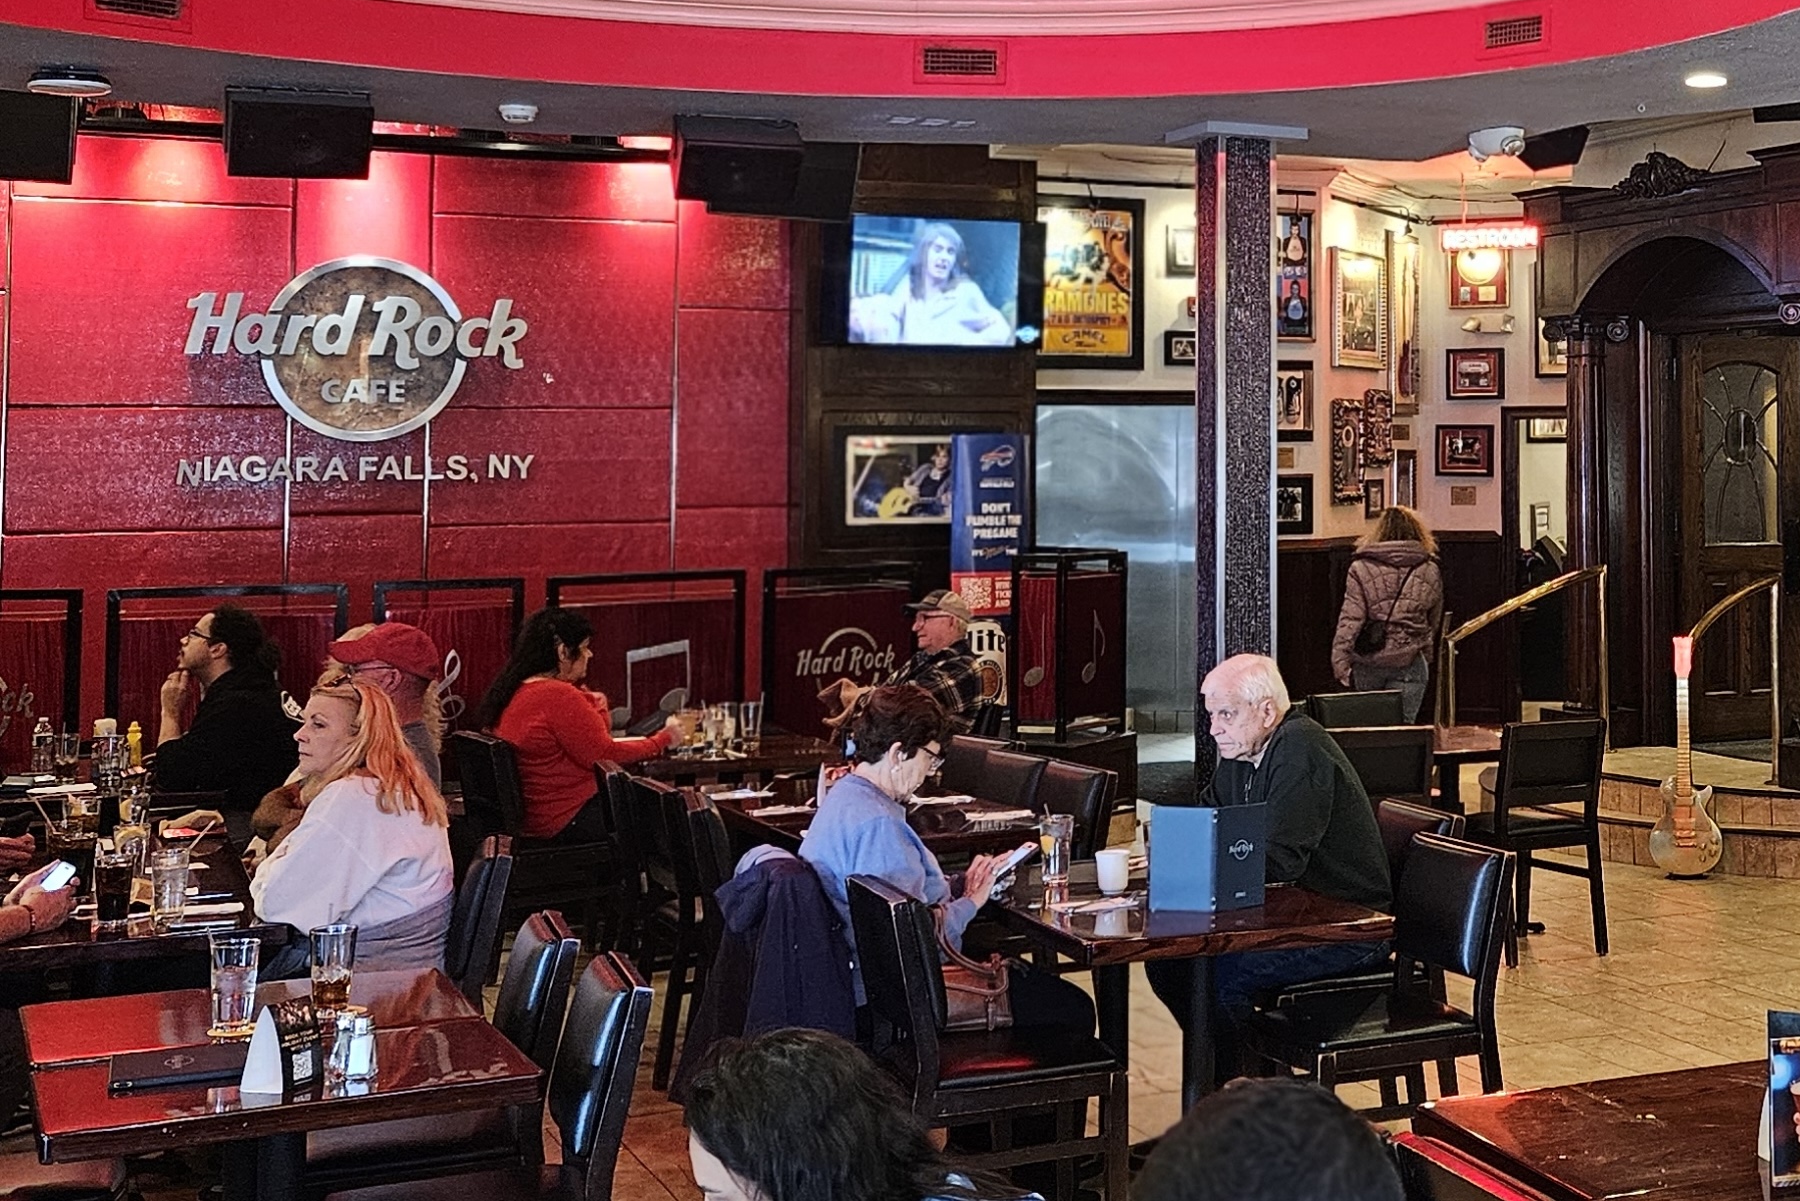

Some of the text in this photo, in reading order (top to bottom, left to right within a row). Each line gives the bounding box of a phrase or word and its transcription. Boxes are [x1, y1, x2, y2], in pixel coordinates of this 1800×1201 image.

[1045, 289, 1129, 314] RAMONES
[184, 292, 528, 370] Hard Rock
[1062, 329, 1108, 344] CAMEL
[321, 378, 406, 405] CAFE
[176, 453, 535, 487] NIAGARA FALLS, NY
[965, 515, 1007, 527] FUMBLE
[981, 503, 1011, 514] DON'T
[973, 527, 1018, 539] PREGAME
[995, 590, 1012, 599] TICK
[796, 643, 896, 677] Hard Rock
[2, 683, 34, 718] ck
